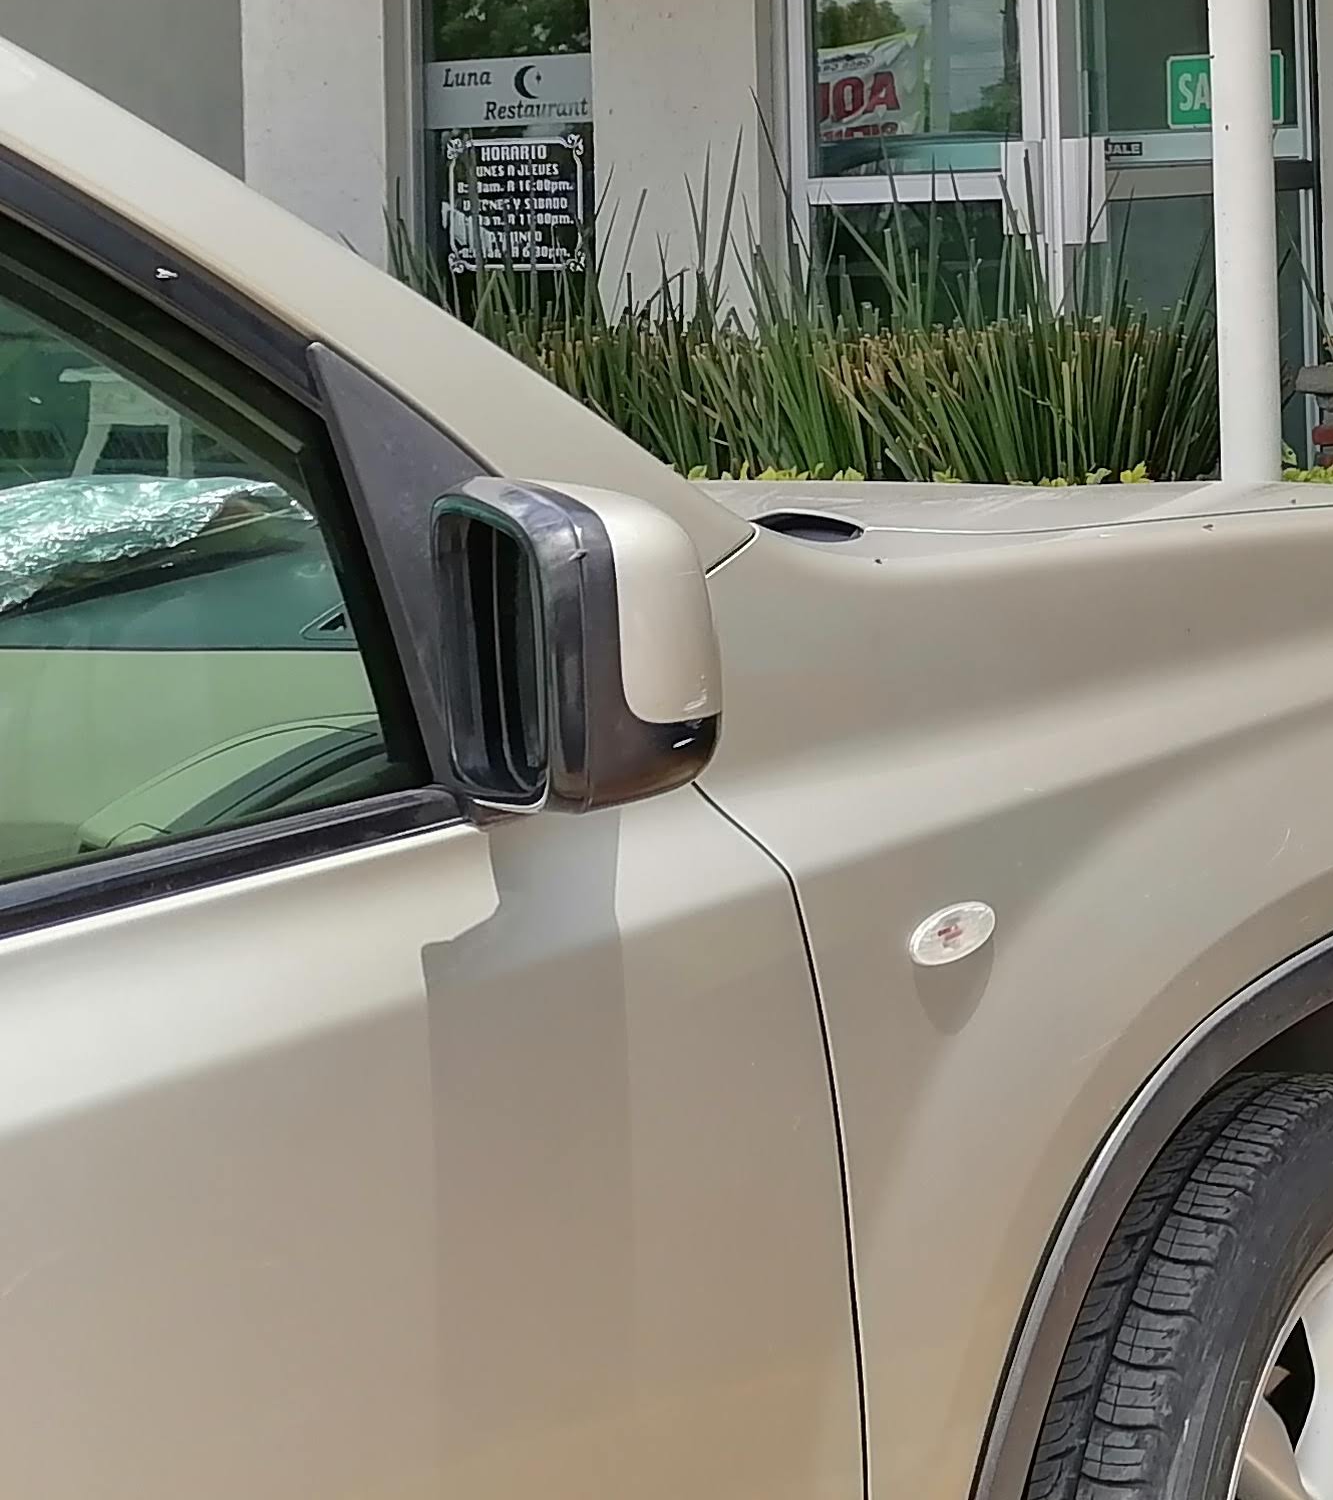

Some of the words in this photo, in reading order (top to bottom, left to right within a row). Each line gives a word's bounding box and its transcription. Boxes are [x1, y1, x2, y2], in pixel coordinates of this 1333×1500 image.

[442, 67, 492, 88] Luna
[484, 98, 589, 121] Restaurant
[481, 144, 548, 162] HORARIO
[1105, 143, 1141, 155] JALE
[476, 164, 505, 178] UNES
[507, 164, 516, 177] A
[457, 182, 505, 194] 8:0am.
[507, 180, 516, 192] A
[514, 198, 522, 212] Y
[507, 214, 516, 226] A
